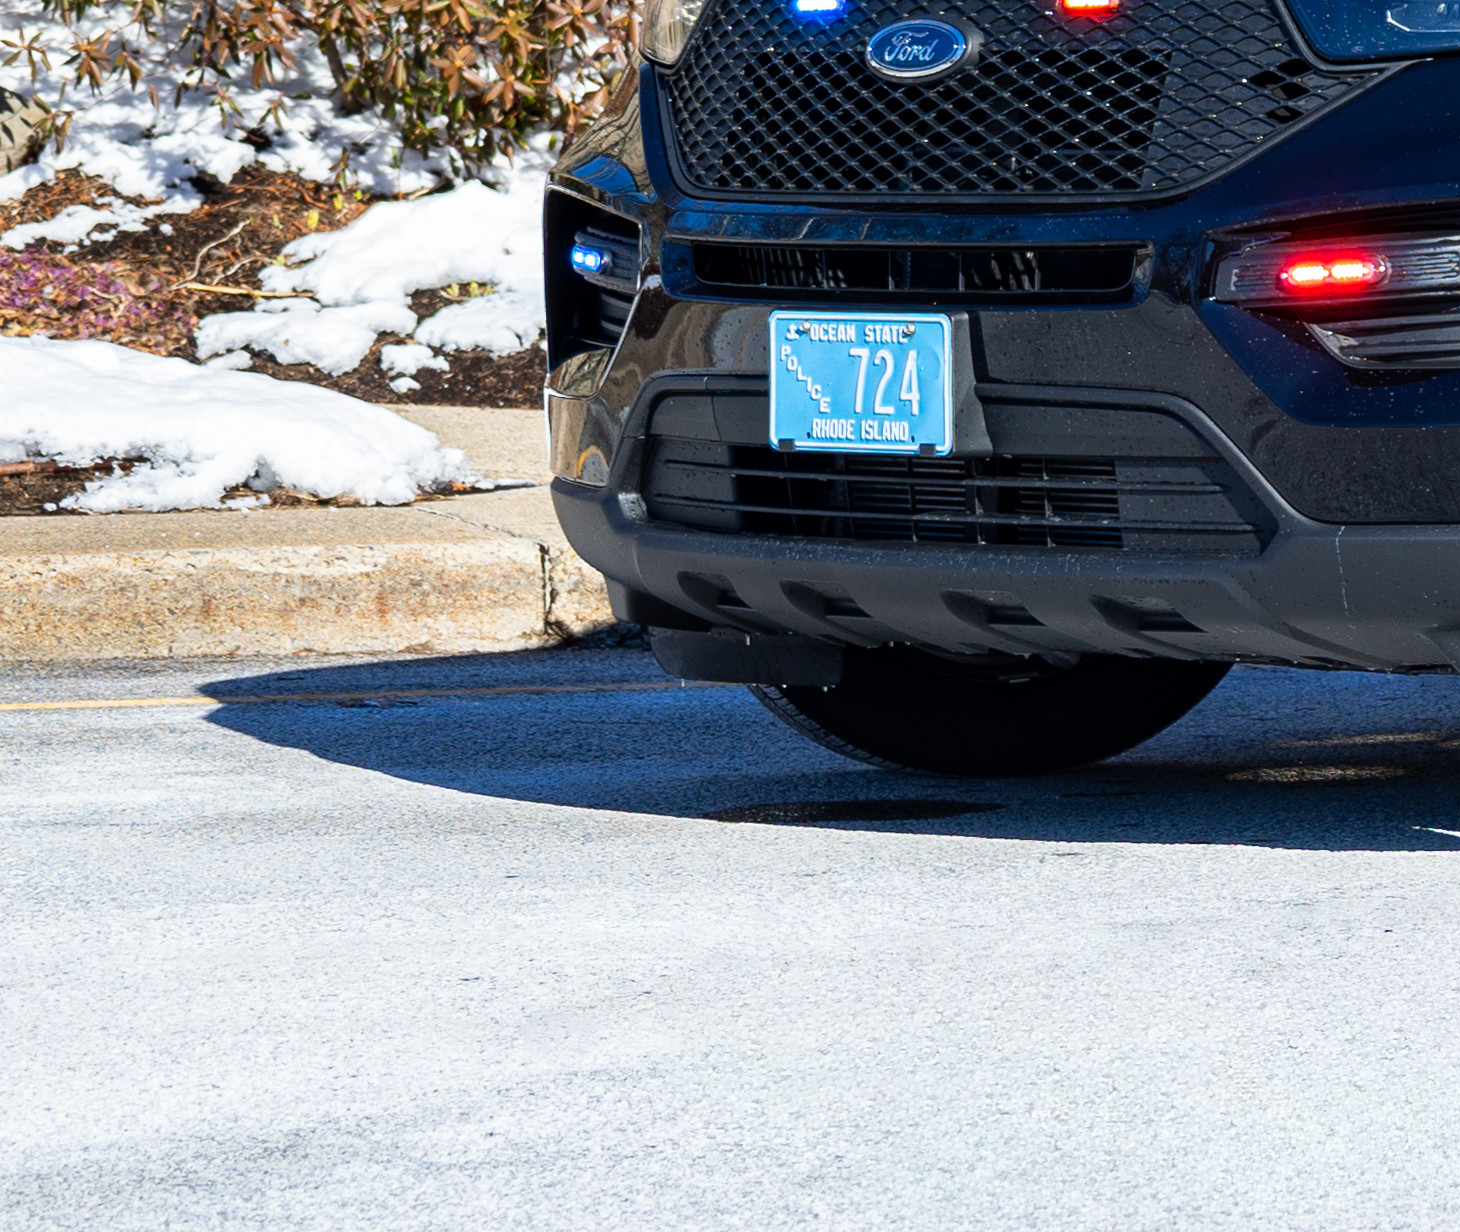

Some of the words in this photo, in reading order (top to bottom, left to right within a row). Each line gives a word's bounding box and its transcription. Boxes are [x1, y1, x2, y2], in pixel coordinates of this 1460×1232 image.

[885, 30, 940, 62] Ford
[809, 323, 855, 343] OCEAN
[780, 344, 831, 414] POLICE
[849, 347, 920, 416] 724
[812, 418, 855, 440] RHODE
[861, 420, 909, 442] ISLAND
